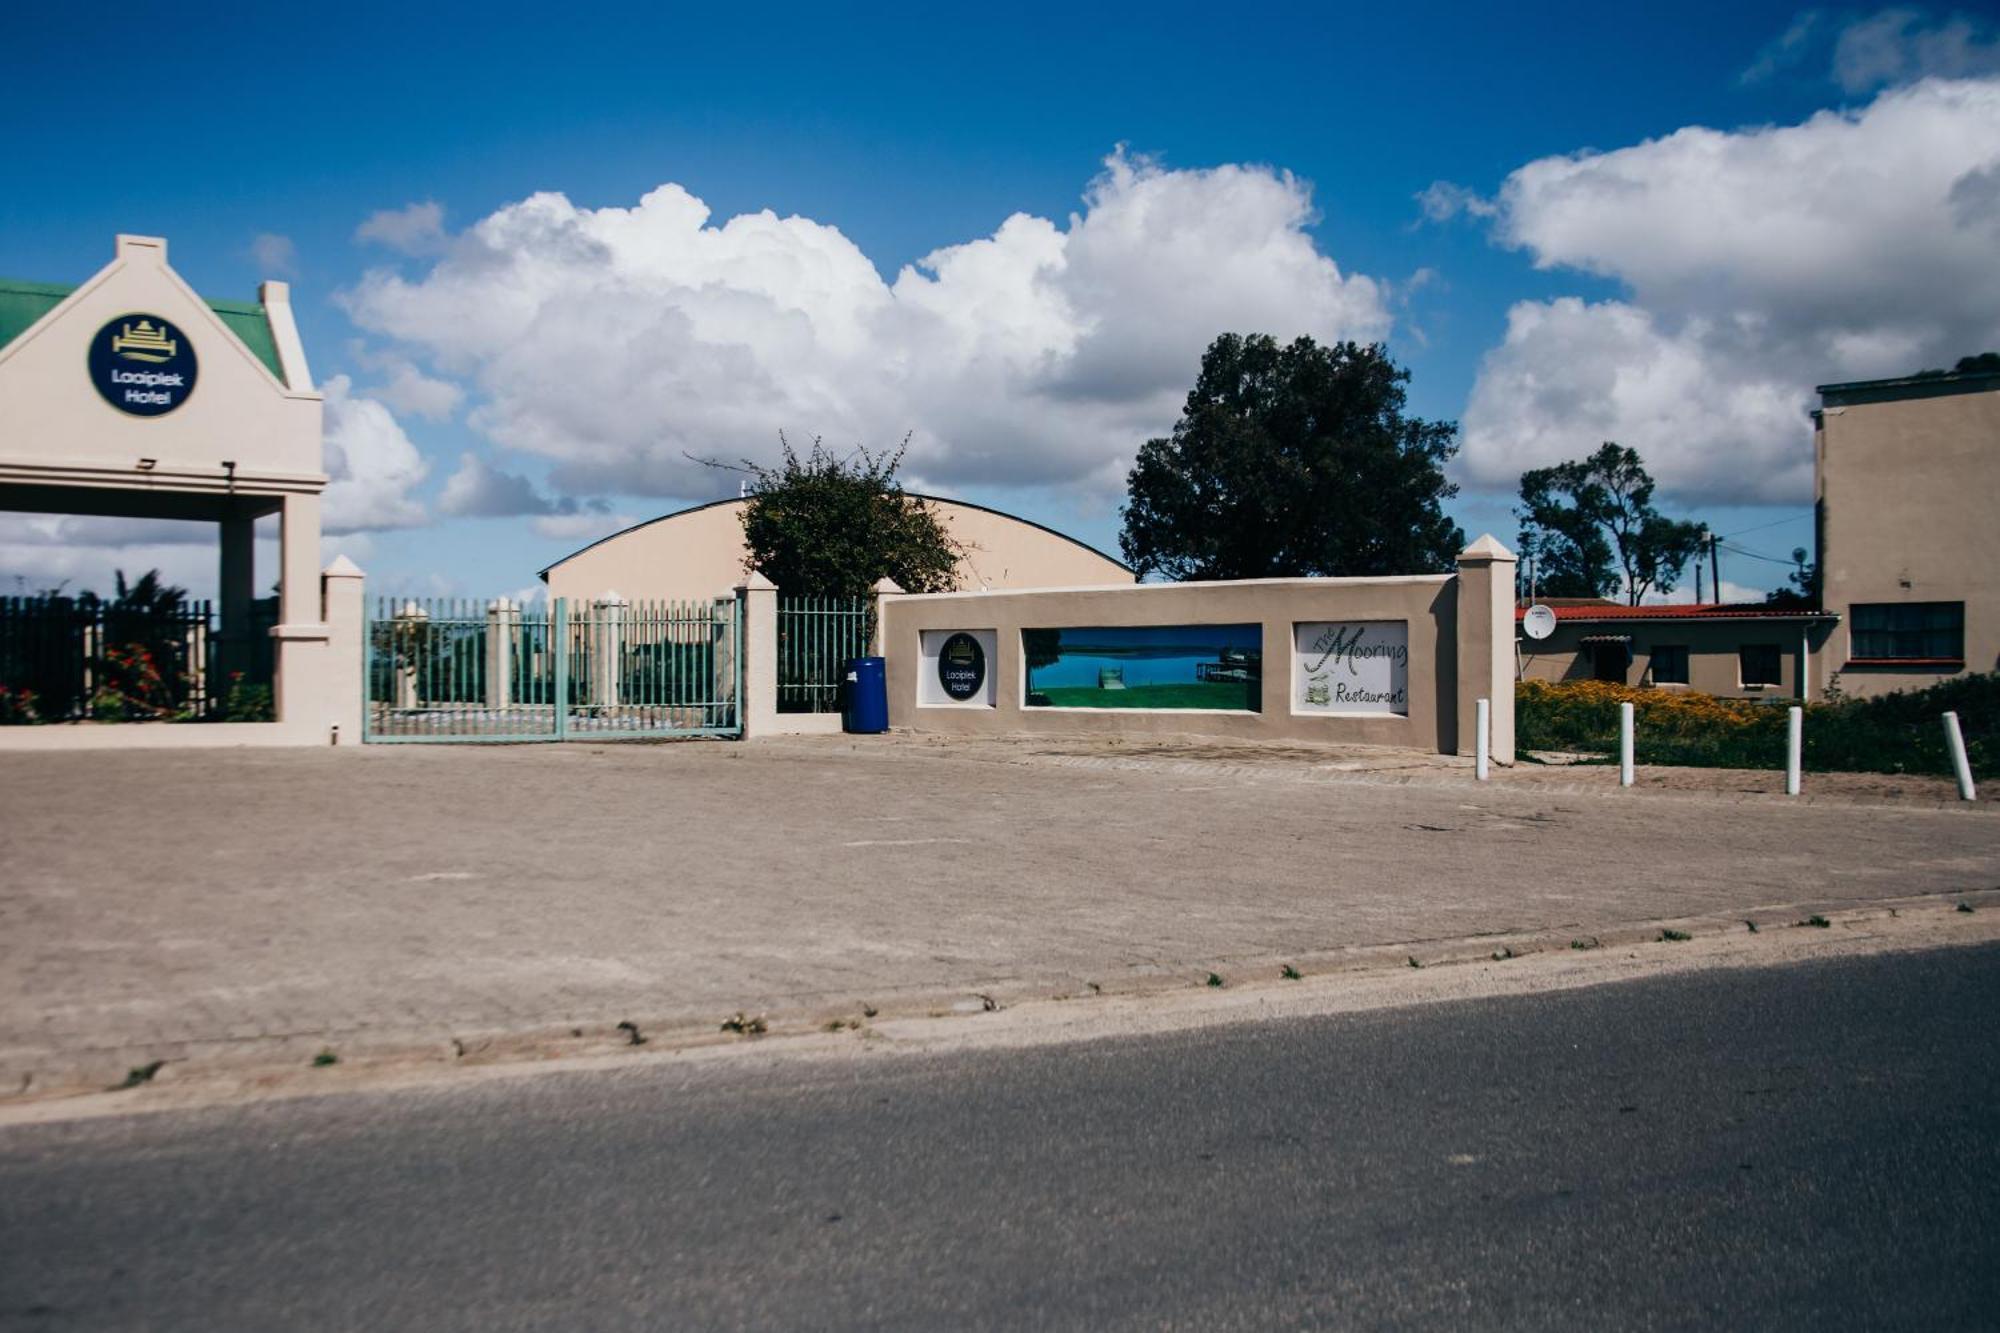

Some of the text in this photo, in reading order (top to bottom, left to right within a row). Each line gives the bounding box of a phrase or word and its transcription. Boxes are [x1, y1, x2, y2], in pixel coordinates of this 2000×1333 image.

[125, 389, 171, 405] Hotel
[951, 682, 970, 691] Hotel
[1335, 682, 1404, 704] Restaurant
